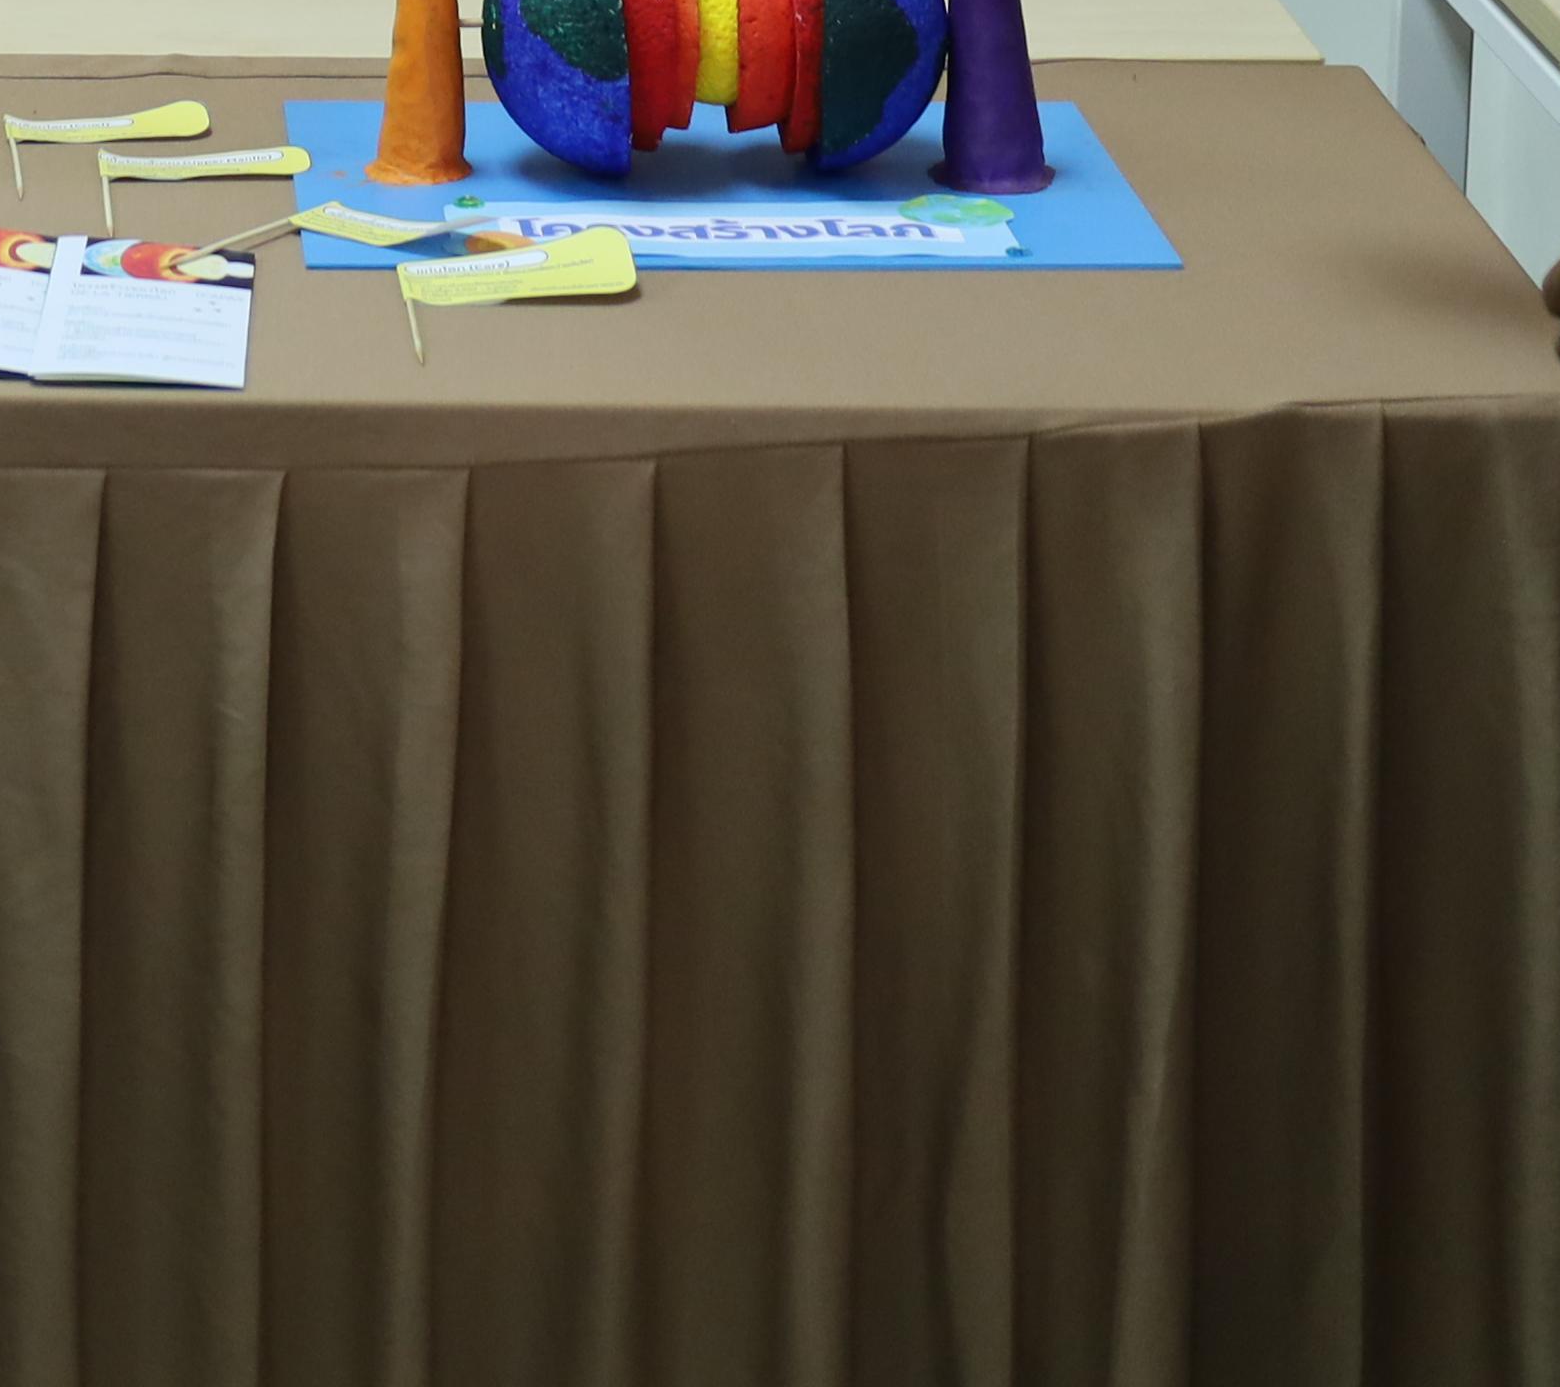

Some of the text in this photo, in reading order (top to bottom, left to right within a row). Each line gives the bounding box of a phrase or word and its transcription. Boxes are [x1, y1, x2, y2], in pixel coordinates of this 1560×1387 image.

[513, 217, 939, 240] โคงสร้างโลก
